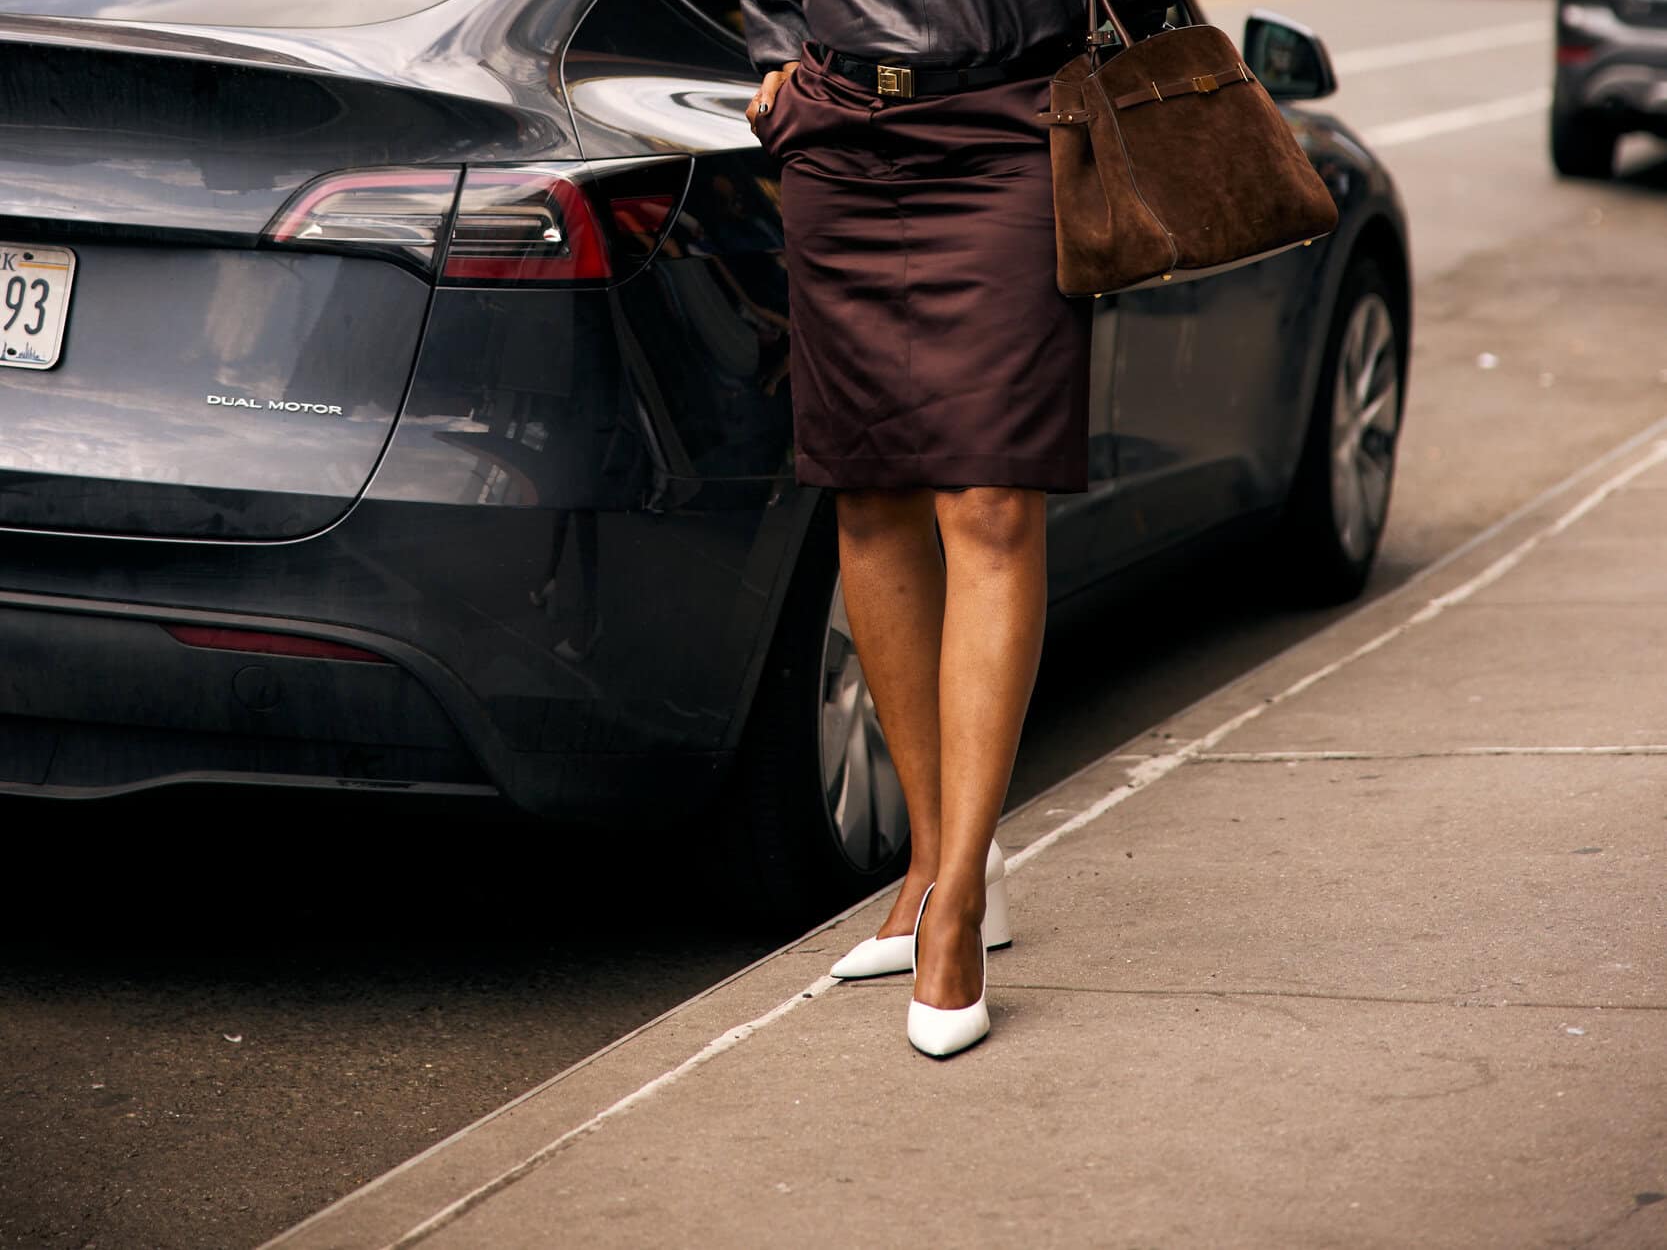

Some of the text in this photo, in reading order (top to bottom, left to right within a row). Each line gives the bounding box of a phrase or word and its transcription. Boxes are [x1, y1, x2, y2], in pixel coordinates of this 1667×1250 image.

[0, 253, 18, 272] K
[3, 275, 50, 335] 93
[207, 395, 343, 415] DUAL MOTOR
